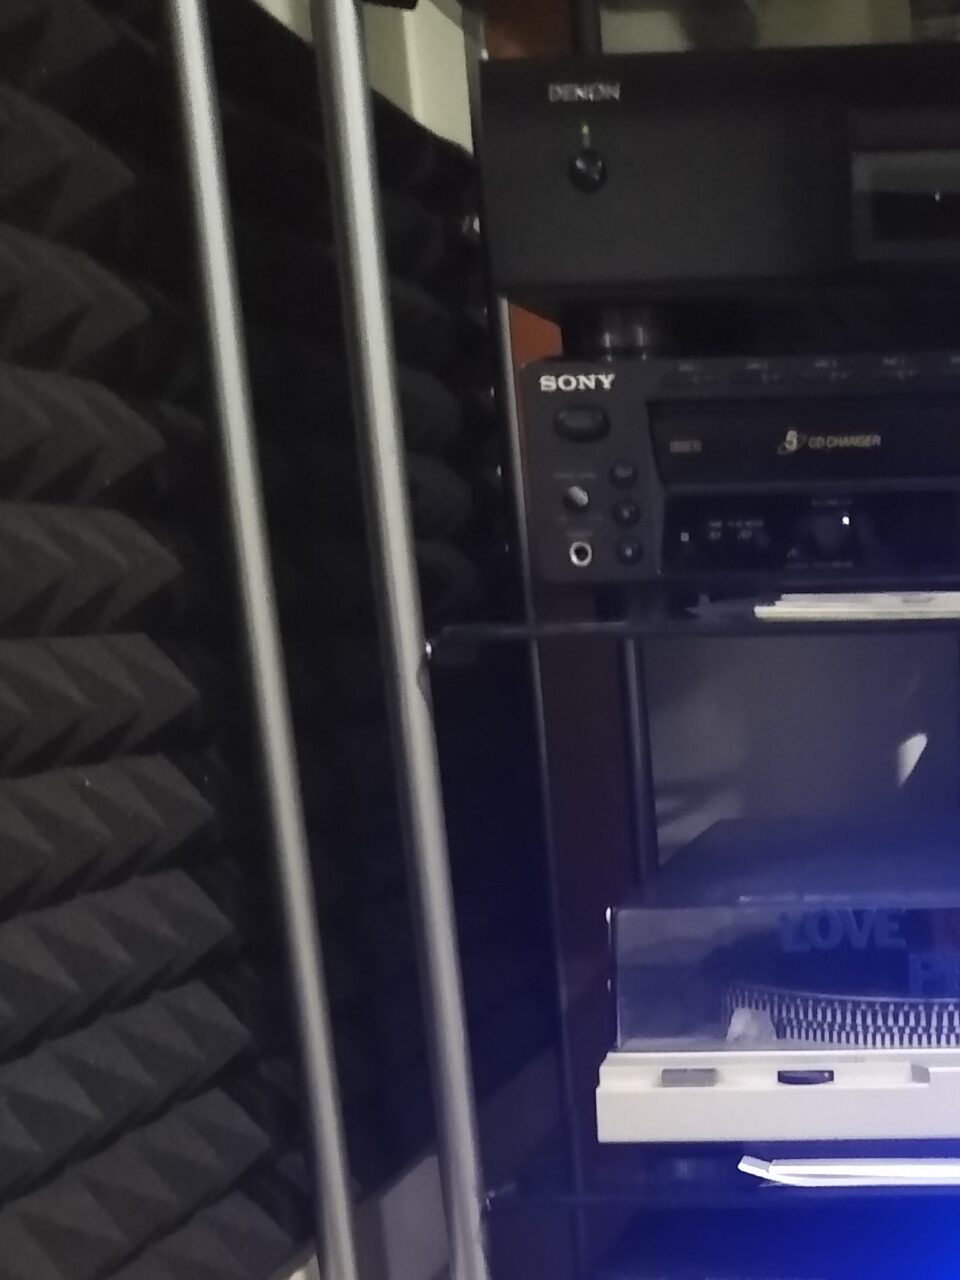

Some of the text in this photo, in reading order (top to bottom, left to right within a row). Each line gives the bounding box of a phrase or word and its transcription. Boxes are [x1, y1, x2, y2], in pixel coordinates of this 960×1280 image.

[539, 373, 615, 392] SONY
[826, 434, 881, 449] CHANGER
[780, 905, 905, 951] LOVE
